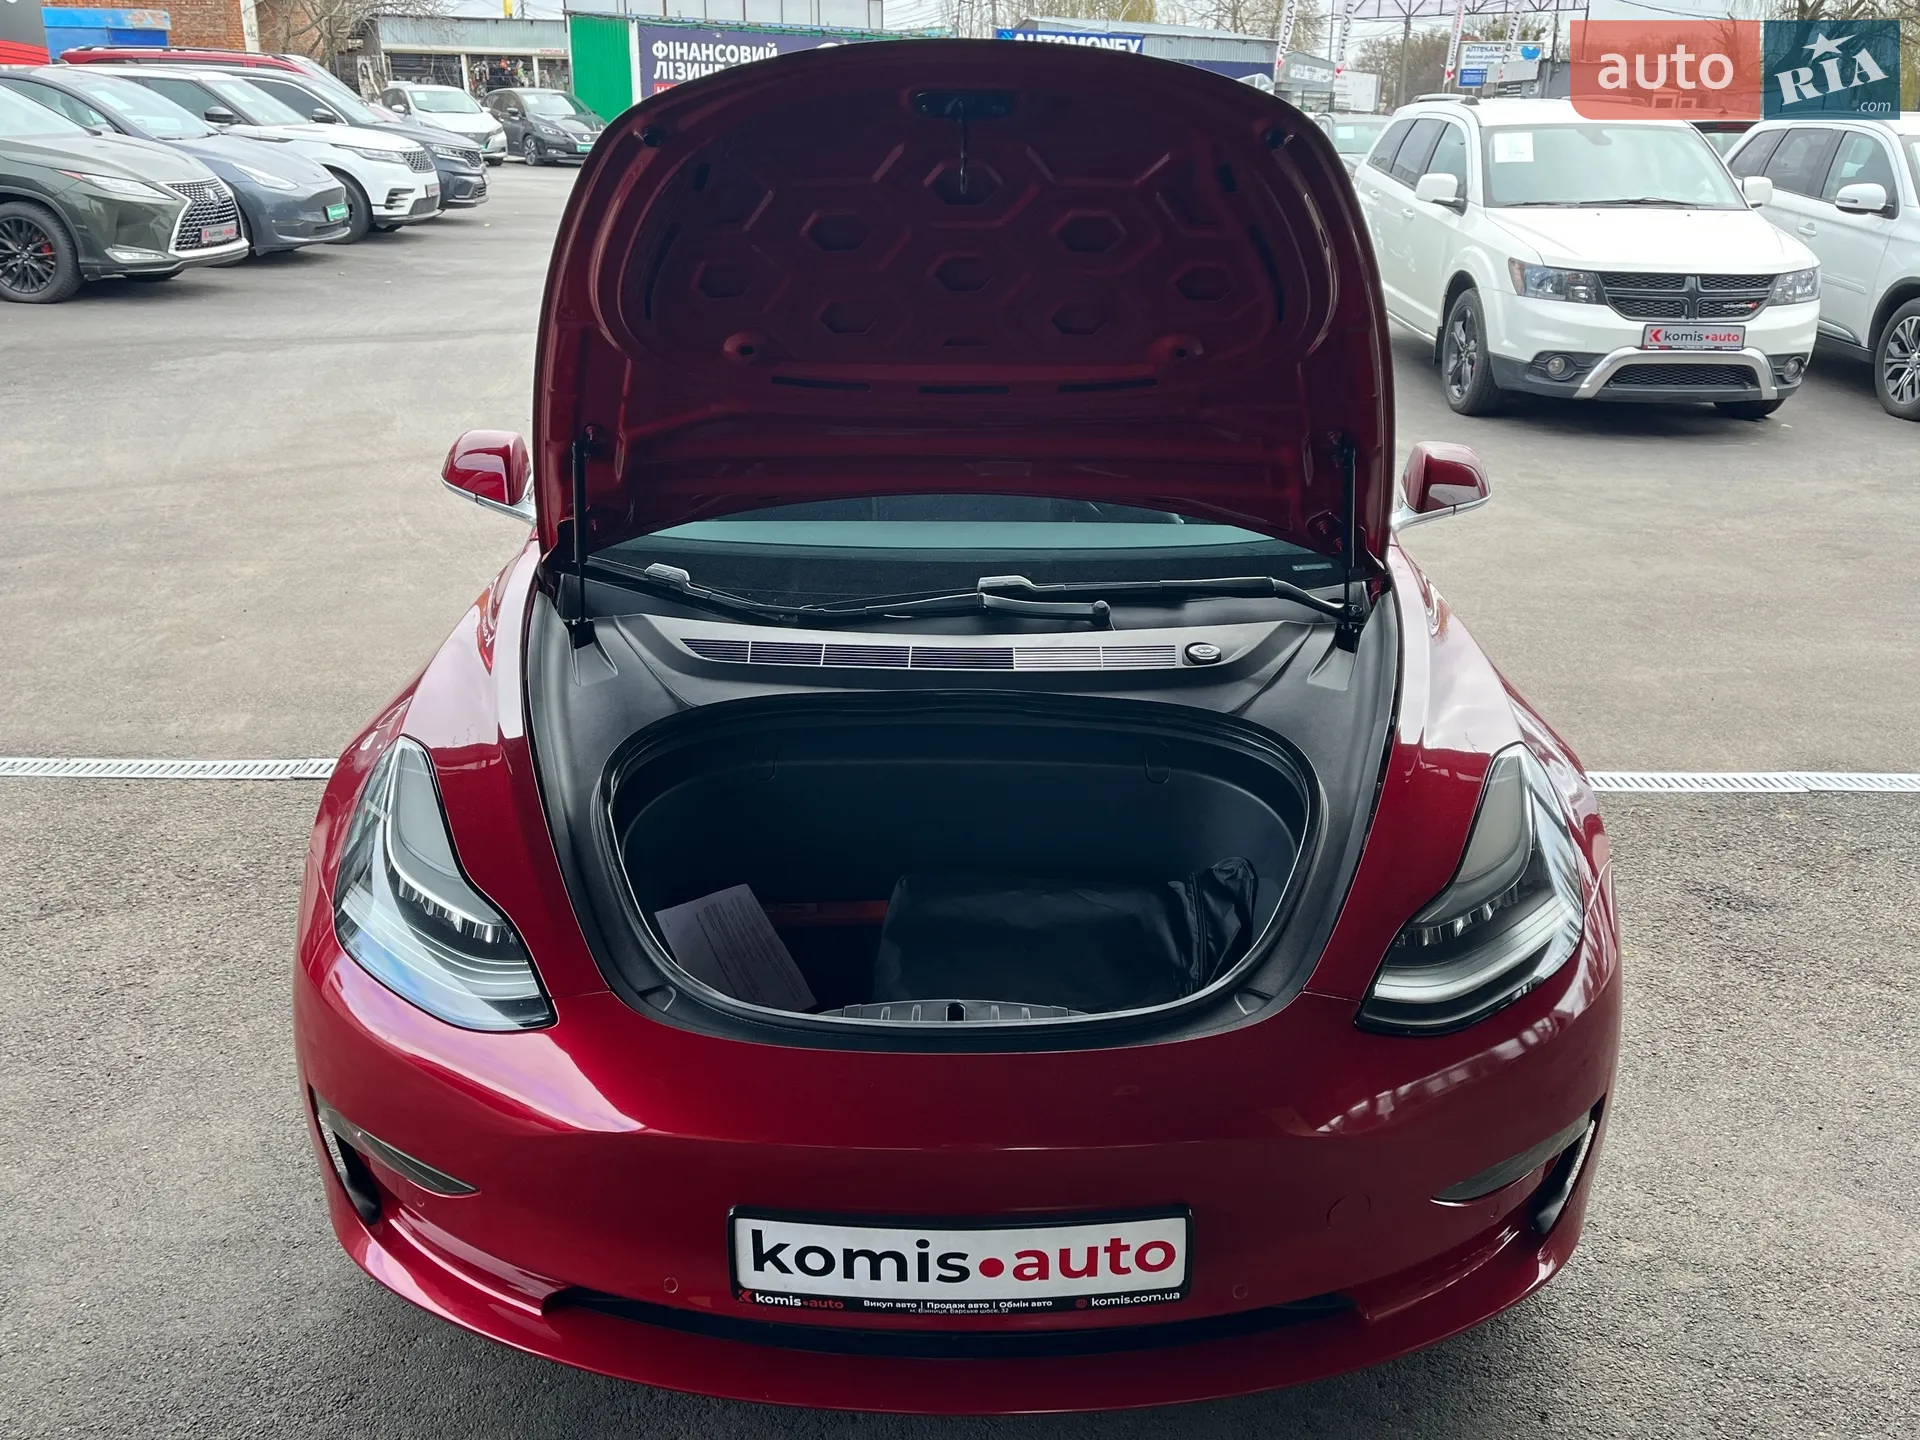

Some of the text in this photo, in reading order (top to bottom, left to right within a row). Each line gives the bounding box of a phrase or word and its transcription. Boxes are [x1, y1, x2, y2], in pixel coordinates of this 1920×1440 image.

[652, 40, 778, 63] ФІНАНСОВИЙ
[863, 1300, 893, 1309] Викуп
[927, 1302, 965, 1310] Продаж
[999, 1301, 1029, 1309] Обмін
[1031, 1300, 1053, 1308] авто
[1091, 1292, 1180, 1307] komis.com.ua
